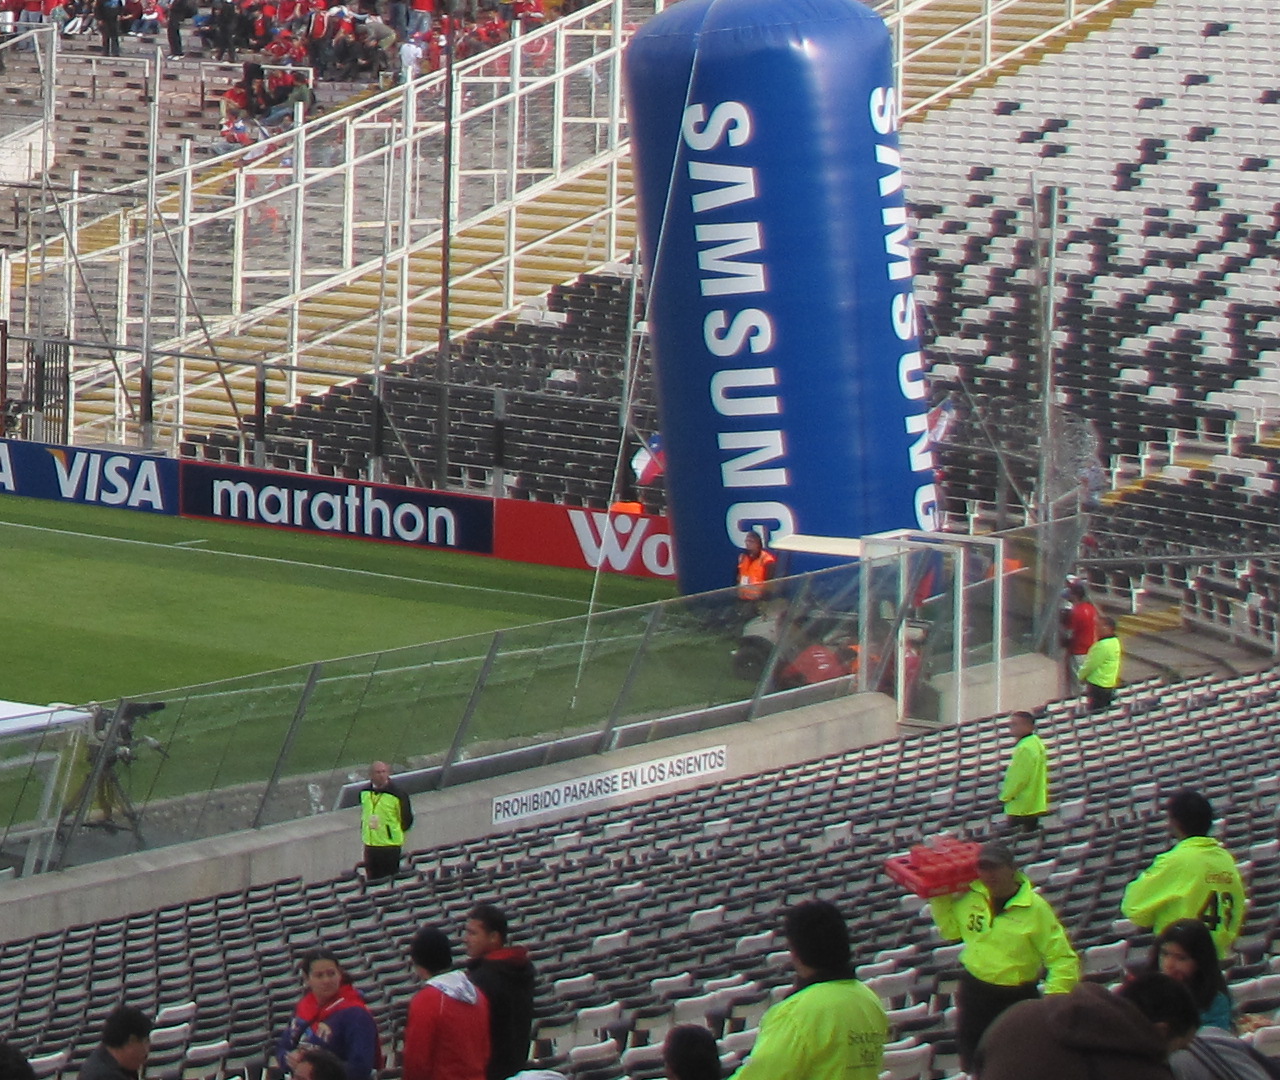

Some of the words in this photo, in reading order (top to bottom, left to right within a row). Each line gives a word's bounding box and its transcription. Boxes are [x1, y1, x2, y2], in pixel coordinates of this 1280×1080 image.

[683, 100, 796, 552] SAMSUNG
[48, 447, 165, 510] VISA
[211, 477, 457, 548] marathon
[494, 787, 562, 820] PROHIBIDO
[563, 774, 619, 804] PARARSE
[621, 770, 638, 790] EN
[640, 763, 666, 786] LOS
[667, 748, 725, 778] ASIENTOS
[966, 913, 985, 933] 35
